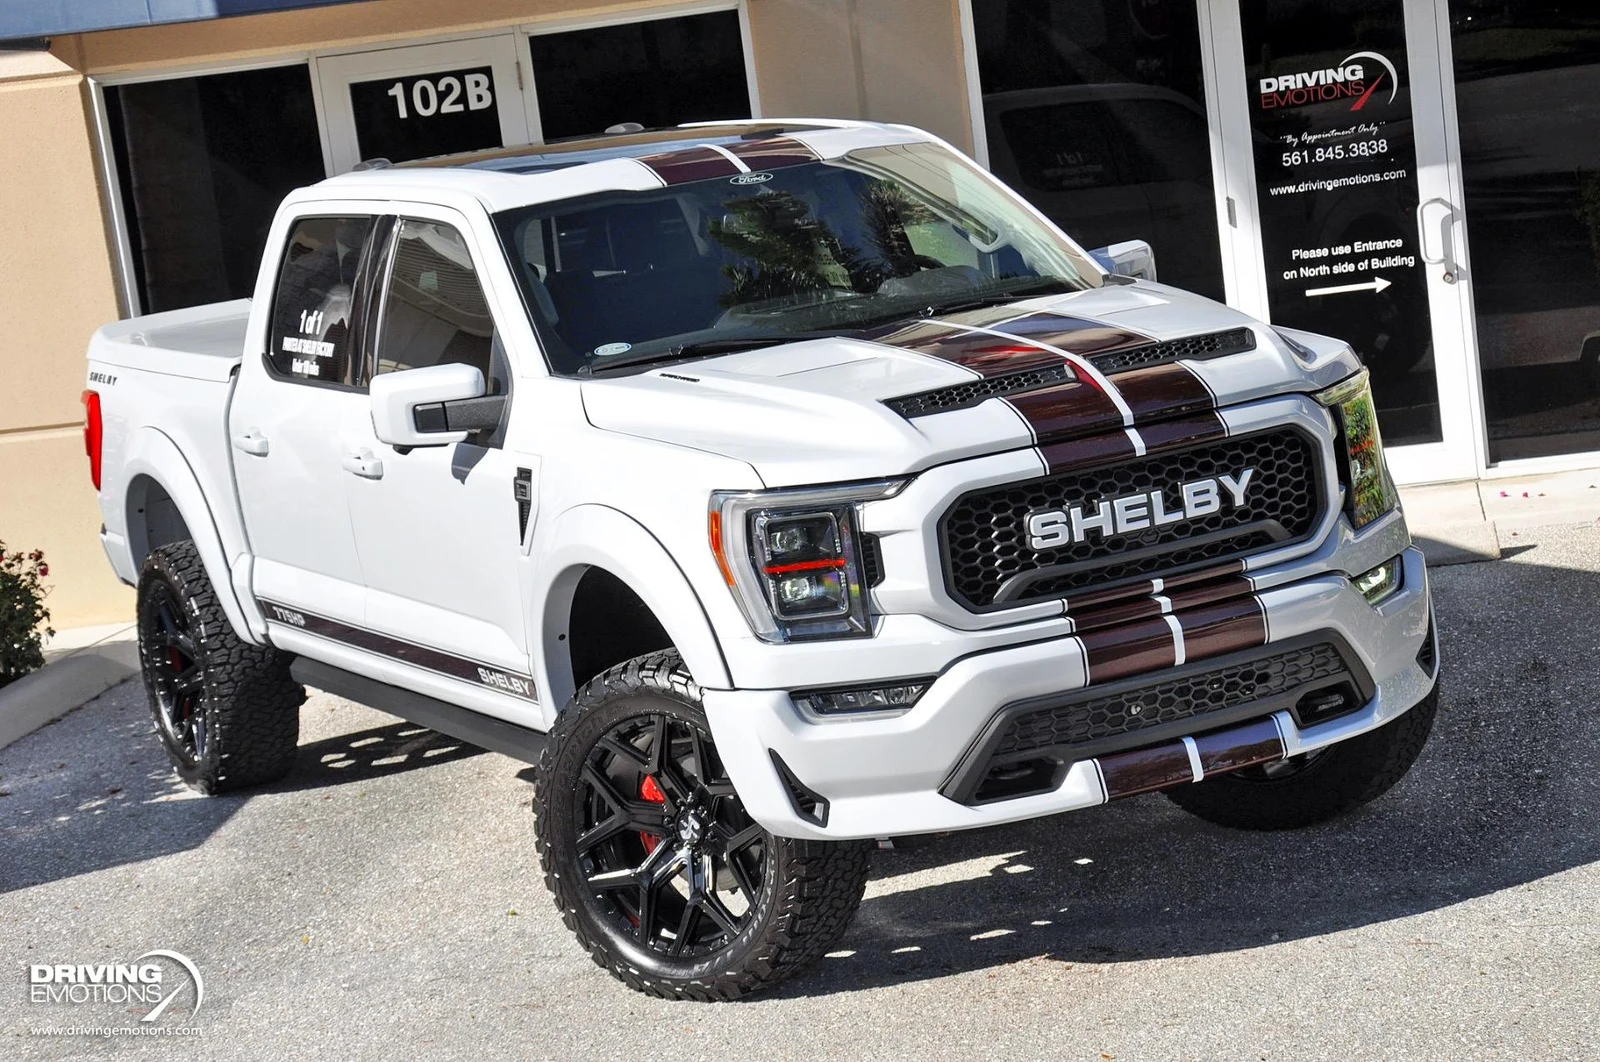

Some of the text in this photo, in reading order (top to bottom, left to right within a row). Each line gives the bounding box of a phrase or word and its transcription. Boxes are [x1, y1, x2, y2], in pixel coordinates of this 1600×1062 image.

[1260, 65, 1364, 94] DRIVING
[387, 73, 493, 119] 102B
[1261, 80, 1365, 109] EMOTIONS
[1301, 126, 1356, 144] Appointment
[1282, 139, 1388, 166] 561.845.3838
[738, 174, 768, 184] Ford
[1270, 169, 1406, 196] www.drivingemotions.com
[1292, 239, 1403, 260] Please use Entrance
[1283, 255, 1415, 280] on North side of Building
[299, 309, 307, 333] 1
[316, 311, 323, 335] 1
[89, 371, 118, 386] SHELBY
[1027, 468, 1255, 551] SHELBY
[272, 606, 306, 627] 775HP
[477, 667, 530, 695] SHELBY
